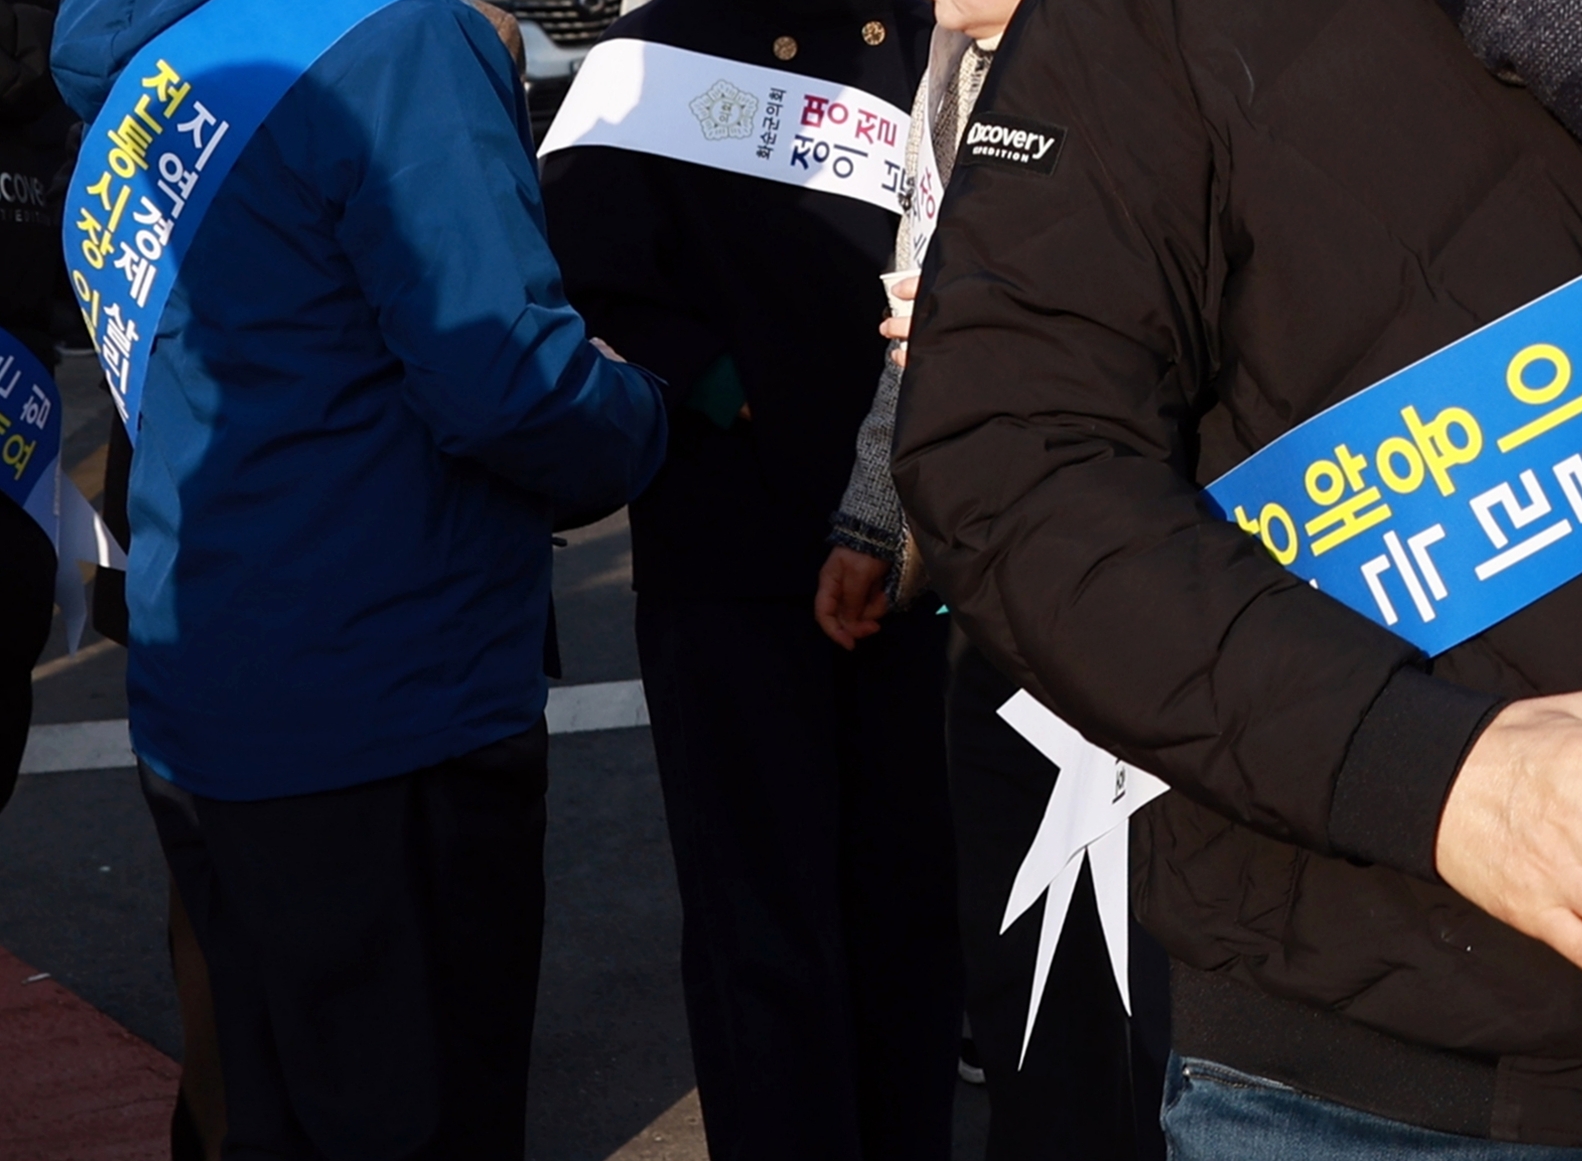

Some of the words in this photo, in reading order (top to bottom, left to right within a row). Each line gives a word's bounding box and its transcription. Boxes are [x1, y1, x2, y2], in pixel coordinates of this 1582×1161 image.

[755, 87, 788, 161] 화순군의회
[789, 134, 868, 179] 정이
[800, 93, 898, 148] 명절
[76, 57, 192, 269] 전통시장
[114, 99, 230, 308] 지역경제
